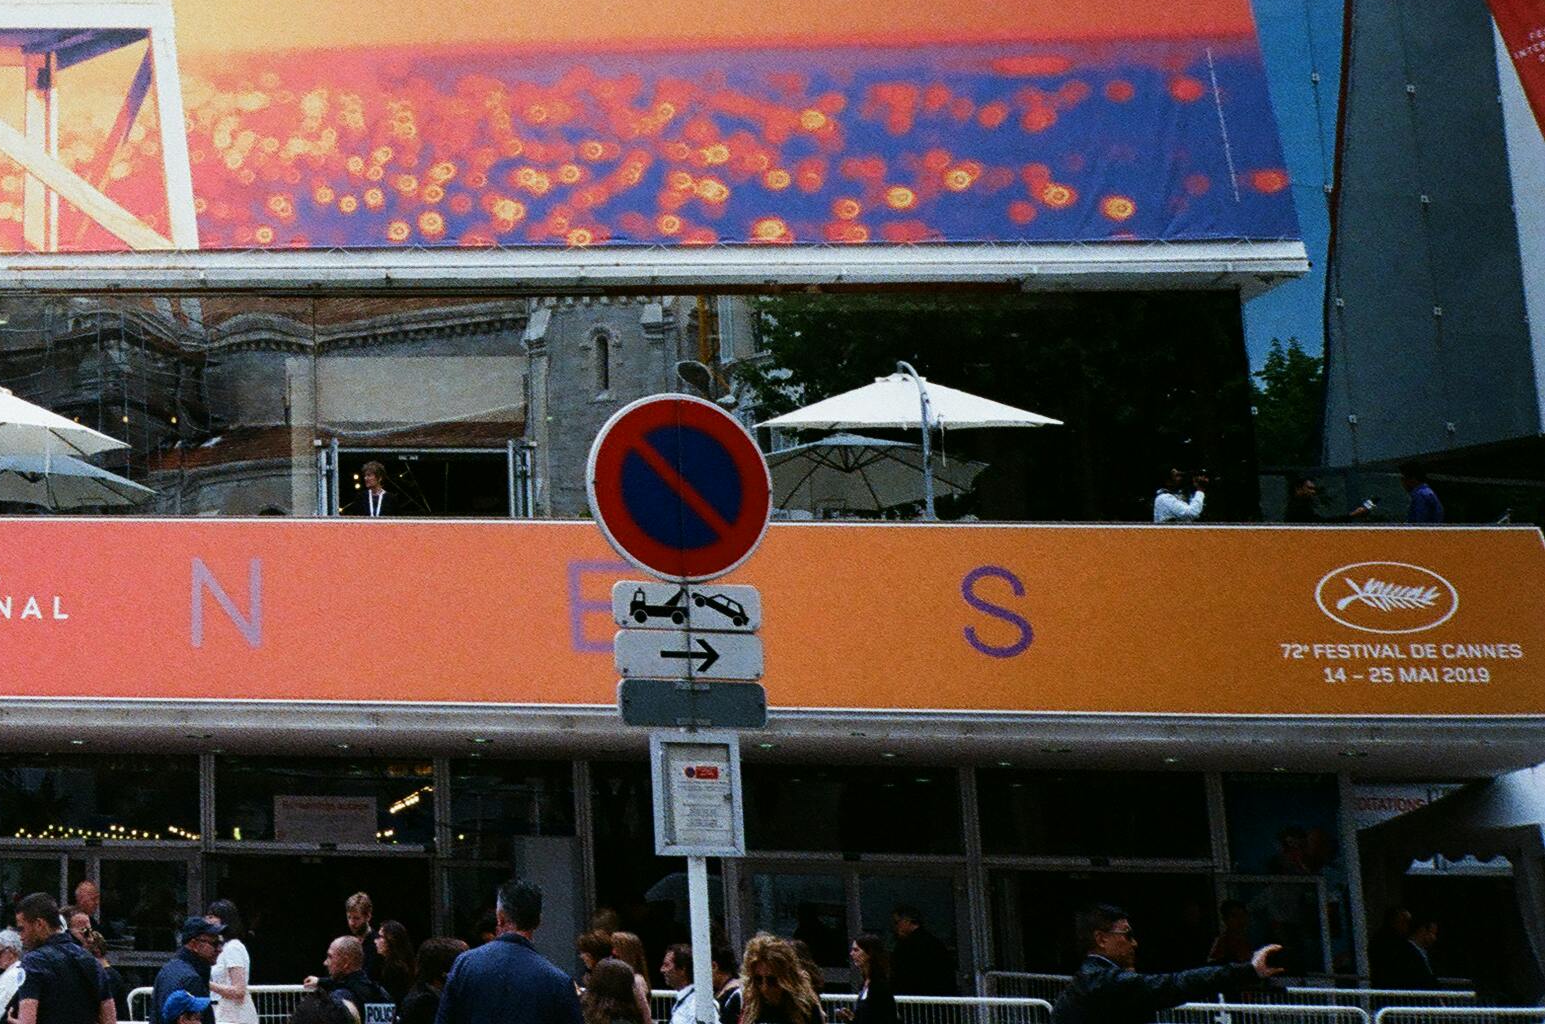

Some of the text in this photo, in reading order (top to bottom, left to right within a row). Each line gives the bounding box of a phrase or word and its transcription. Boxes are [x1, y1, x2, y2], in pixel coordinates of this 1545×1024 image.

[1313, 643, 1407, 660] FESTIVAL
[1410, 643, 1438, 659] DE
[1441, 643, 1524, 660] CANNES
[1323, 667, 1347, 683] 14
[1368, 667, 1395, 683] 25
[1398, 667, 1439, 683] MAI
[1442, 667, 1491, 683] 2019
